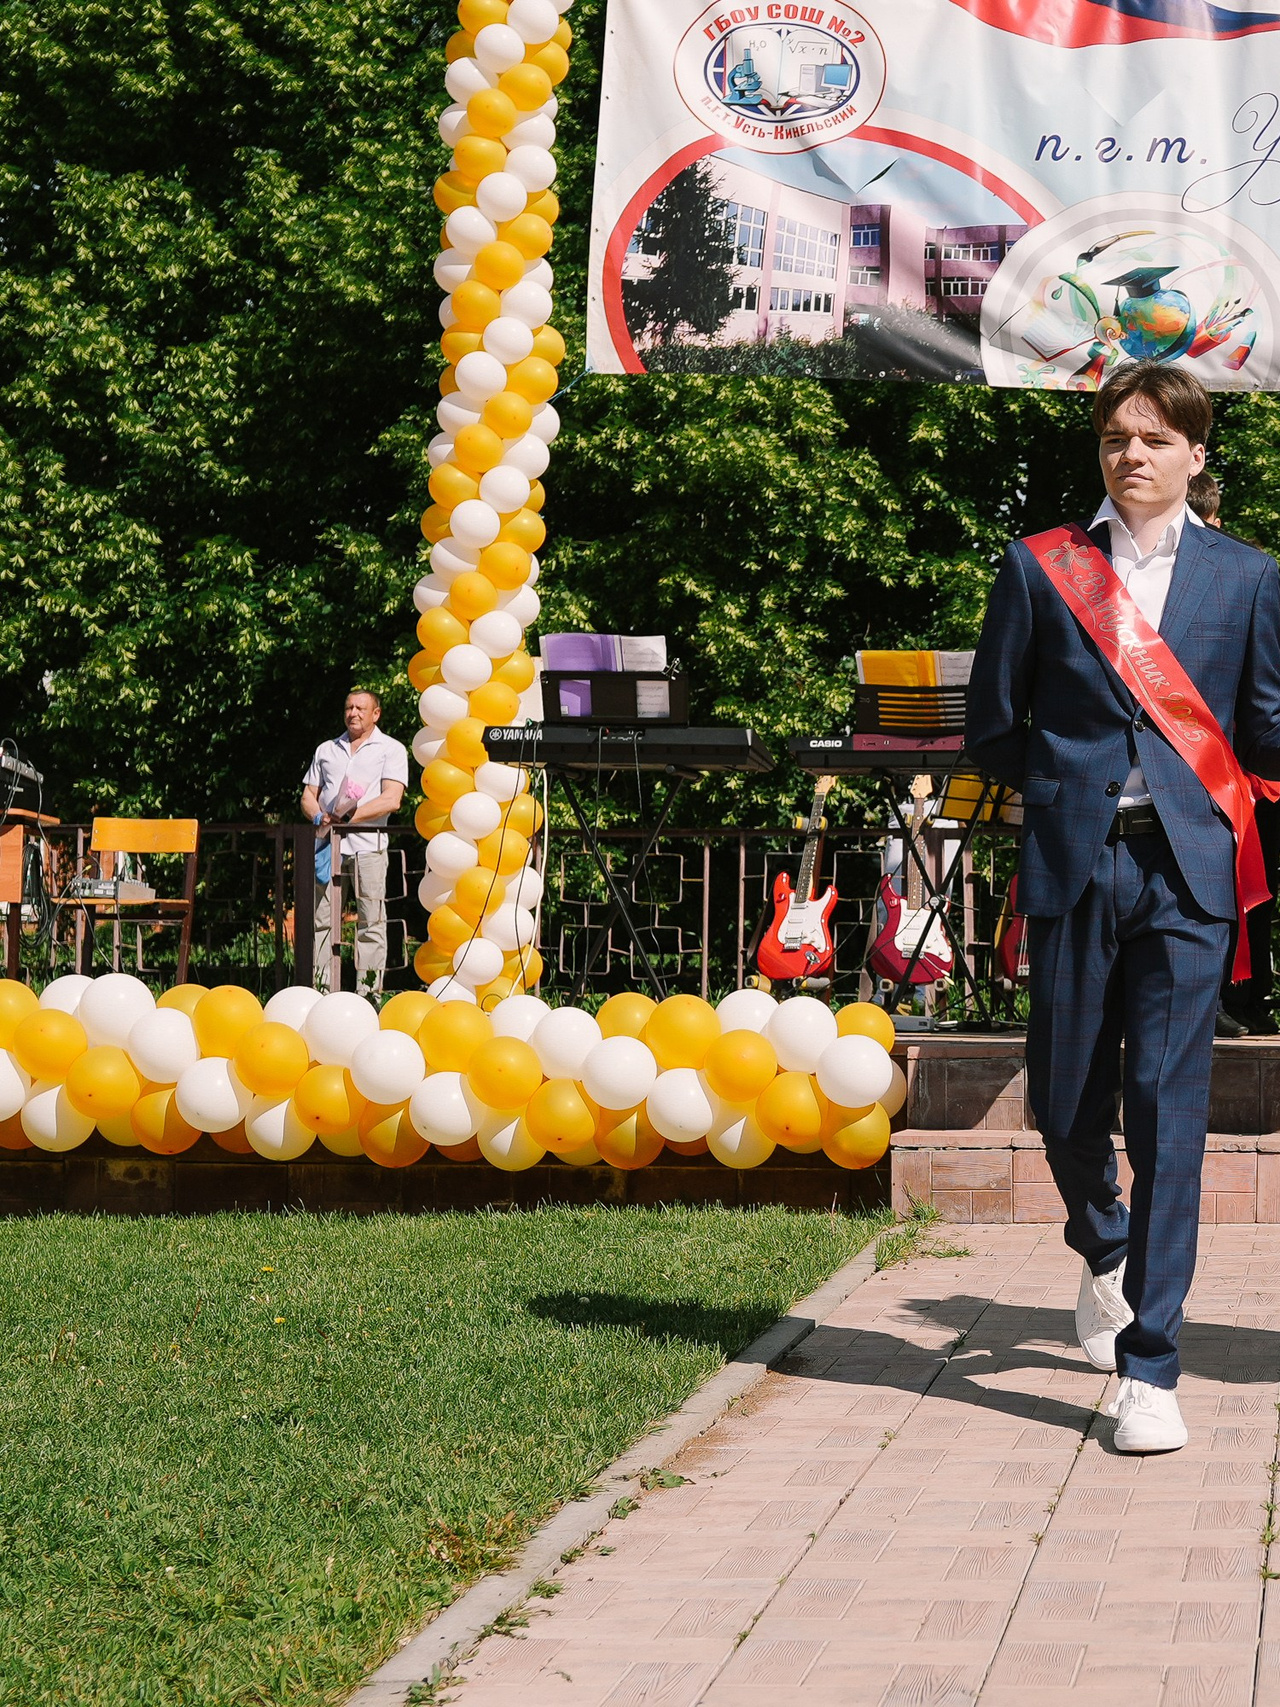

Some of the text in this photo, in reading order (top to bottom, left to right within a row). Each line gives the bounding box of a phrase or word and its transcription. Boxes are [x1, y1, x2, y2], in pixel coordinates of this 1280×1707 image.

[703, 5, 759, 42] ГБОУ
[767, 3, 825, 25] СОШ
[1034, 133, 1208, 165] п.г.т.
[1072, 571, 1209, 743] Выпускник 2025
[502, 728, 543, 741] YAMAHA
[809, 739, 843, 748] CASIO
